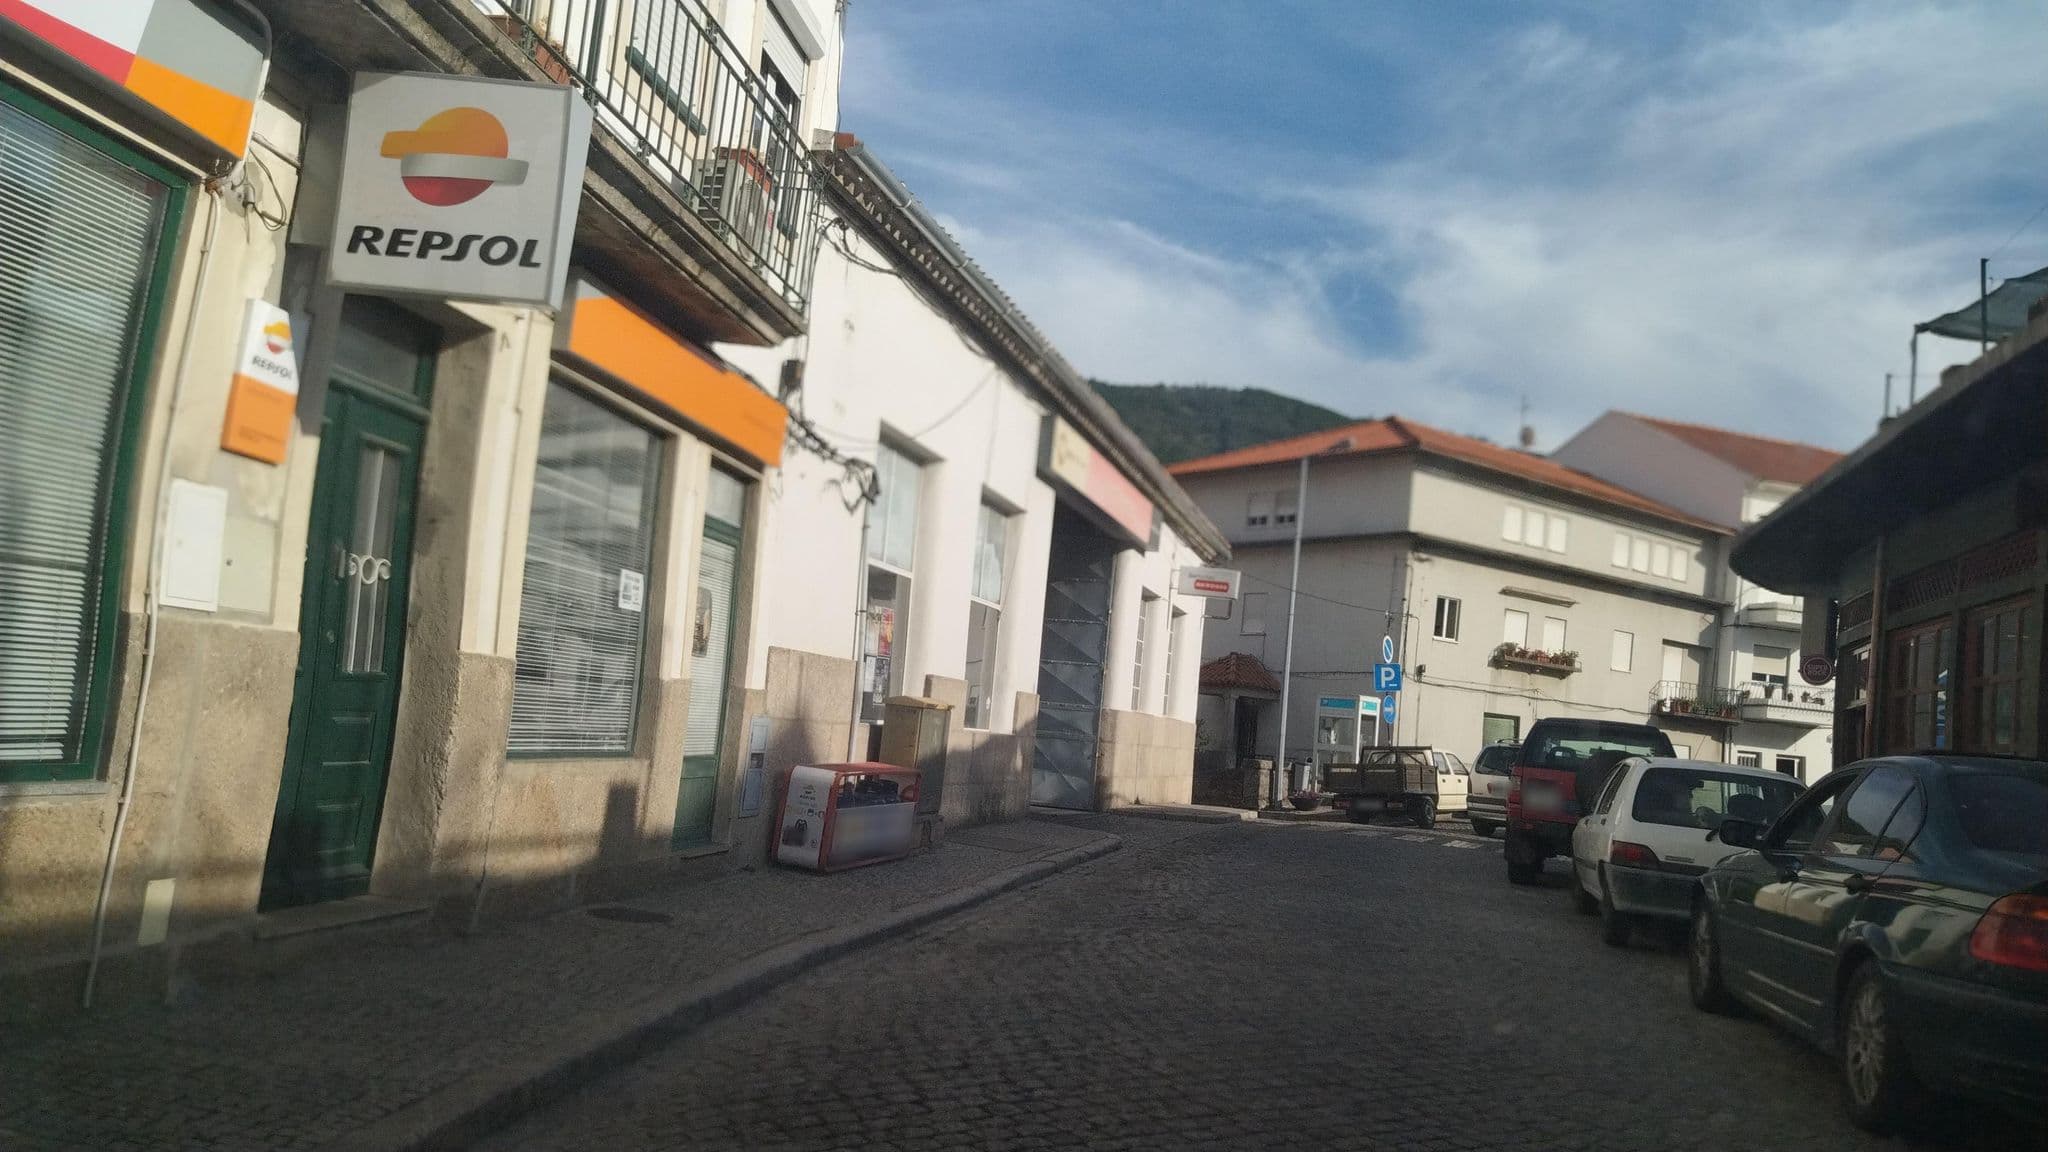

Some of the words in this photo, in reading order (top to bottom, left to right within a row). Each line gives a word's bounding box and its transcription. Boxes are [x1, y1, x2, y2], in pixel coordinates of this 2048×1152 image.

[346, 225, 542, 268] REPSOL
[252, 355, 293, 380] REPSOL
[1381, 667, 1395, 688] P
